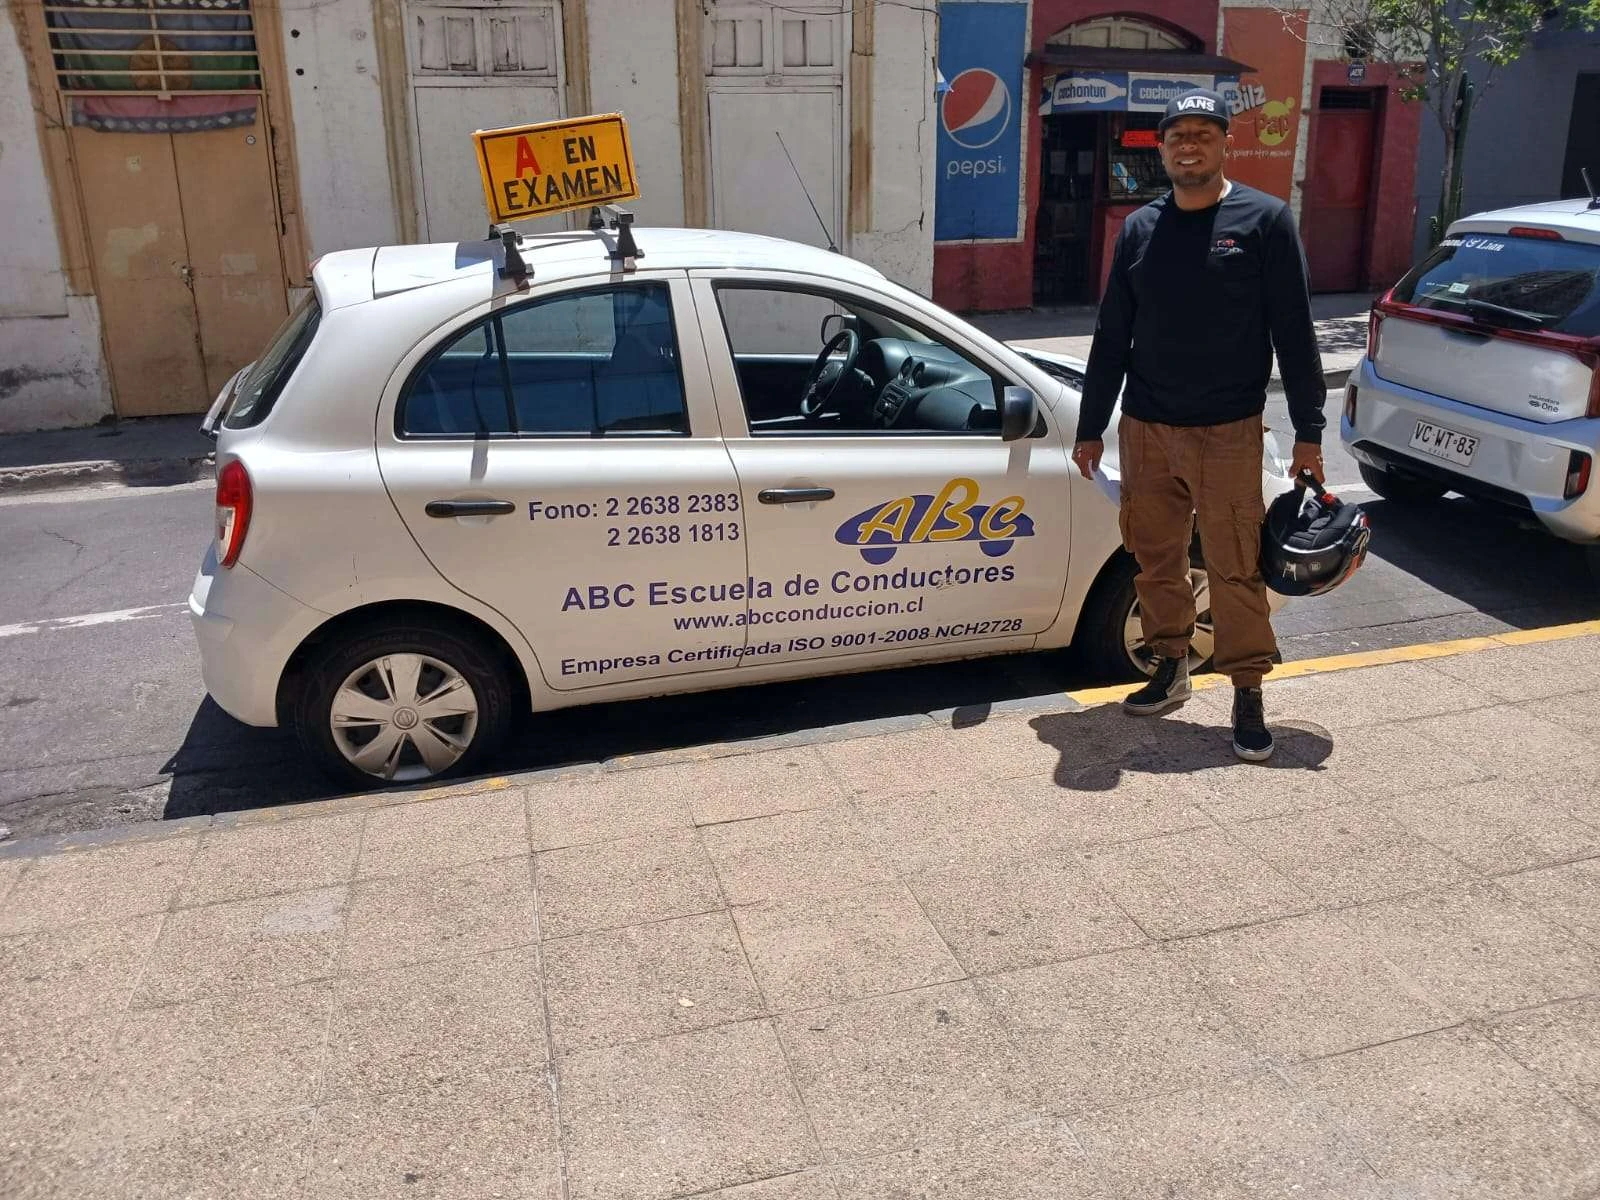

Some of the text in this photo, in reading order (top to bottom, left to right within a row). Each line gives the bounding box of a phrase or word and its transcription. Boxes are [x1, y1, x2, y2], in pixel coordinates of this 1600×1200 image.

[1177, 95, 1216, 112] VANS
[515, 135, 597, 178] A EN
[947, 155, 1002, 180] pepsi
[503, 163, 623, 210] EXAMEN
[1541, 402, 1559, 413] One
[528, 493, 739, 520] Fono: 2 2638 2383
[857, 477, 1025, 544] ABC
[607, 522, 739, 546] 2 2638 1813
[561, 564, 1015, 611] ABC Escuela de Conductores
[674, 596, 924, 630] www.abcconduccion.cl
[561, 618, 1023, 676] Empresa Certificada ISO 9001-2008 NCH2728
